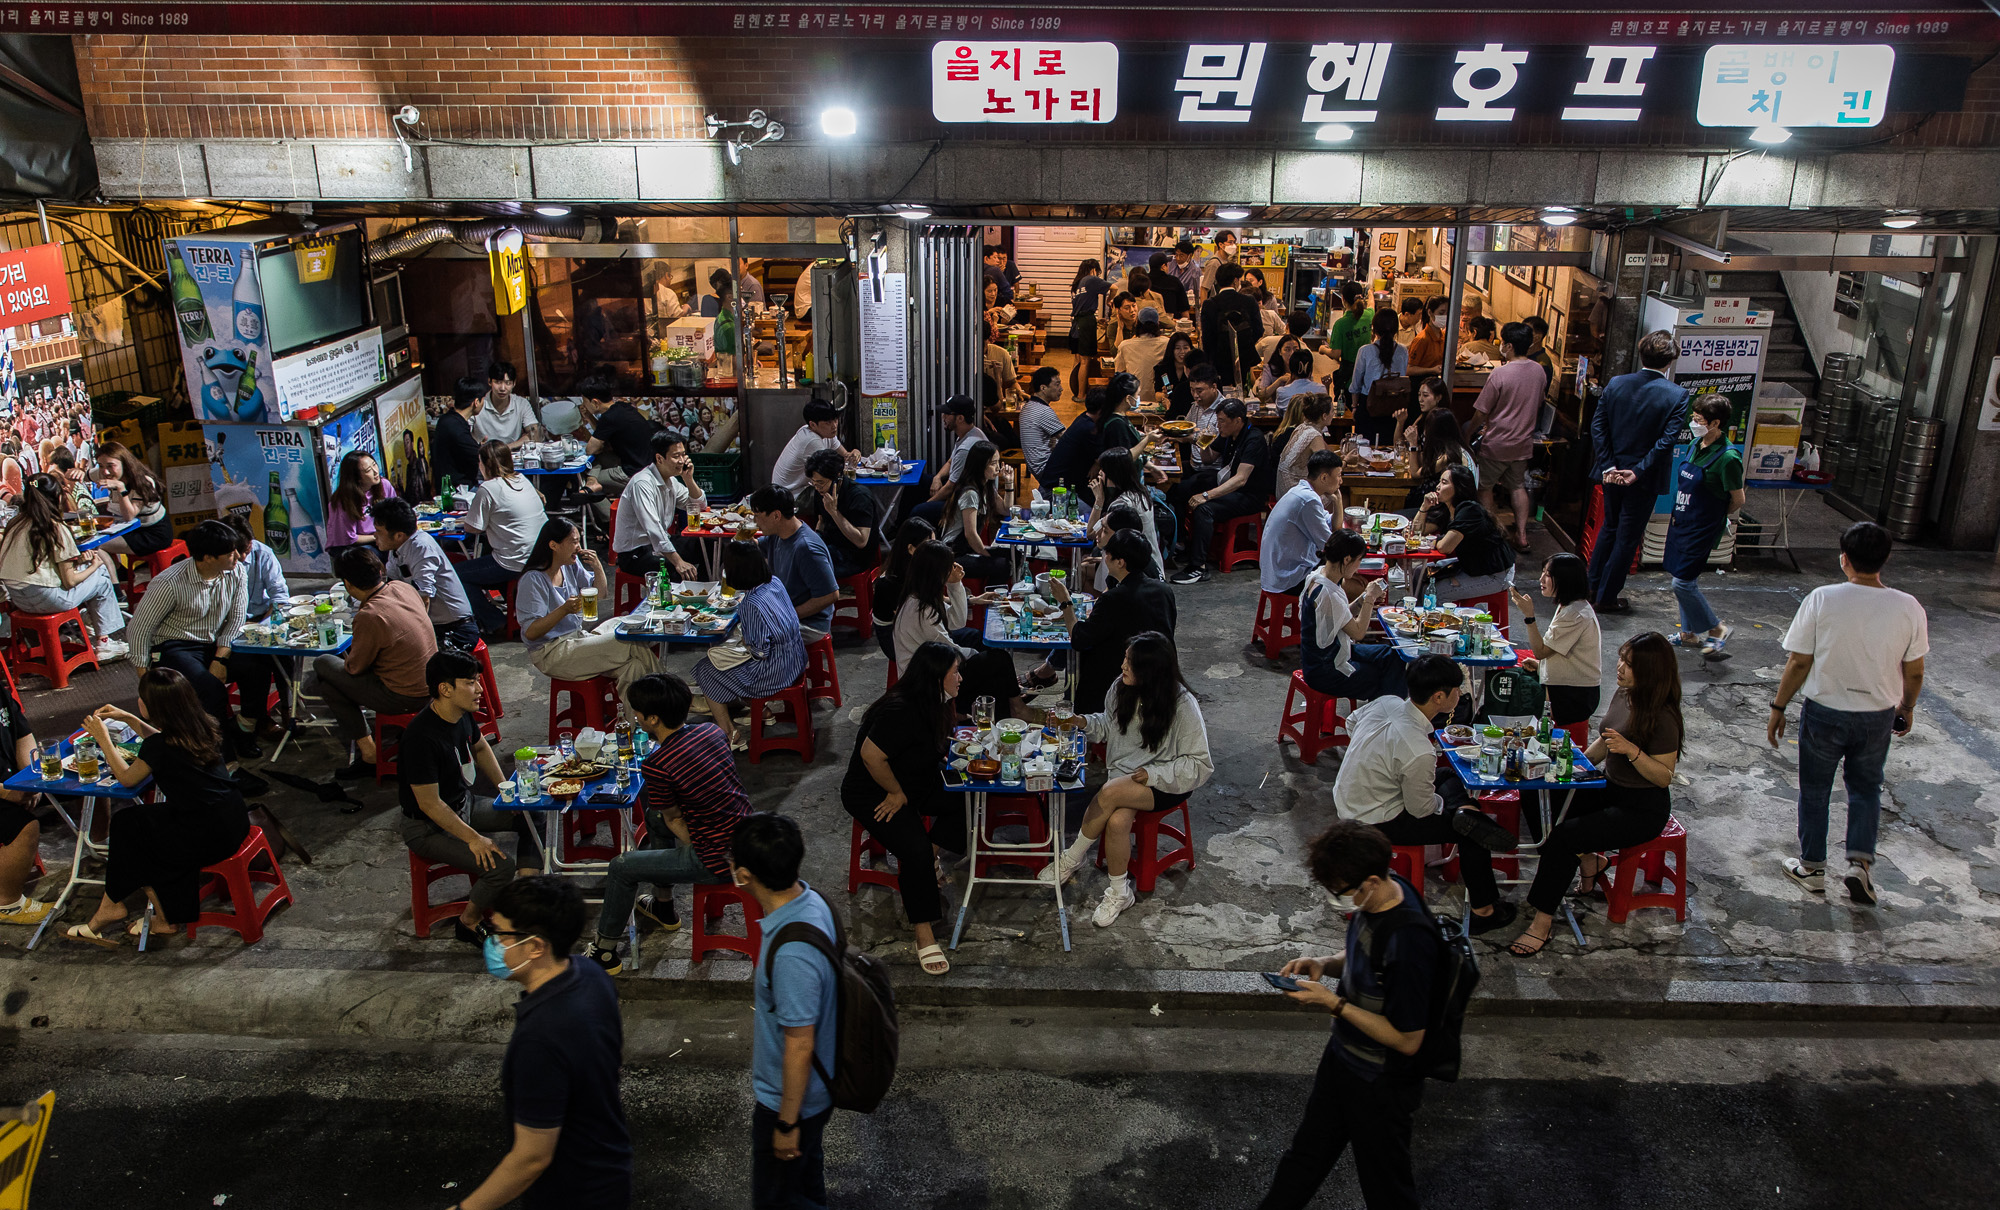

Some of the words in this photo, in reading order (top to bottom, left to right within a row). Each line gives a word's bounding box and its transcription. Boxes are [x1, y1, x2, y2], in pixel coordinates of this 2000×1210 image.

[0, 10, 19, 25] 리
[30, 10, 113, 26] 을지로골뱅이
[121, 13, 154, 26] Since
[159, 13, 189, 25] 1989
[733, 14, 790, 29] 뮌헨호프
[798, 13, 885, 29] 을지로노가리
[895, 15, 984, 31] 을지로골뱅이
[991, 17, 1024, 30] Since
[1029, 16, 1062, 30] 1989
[1609, 21, 1670, 36] 뮌헨호프
[1676, 20, 1768, 36] 을지로노가리
[1776, 21, 1868, 36] 을지로골뱅이
[1875, 21, 1910, 35] Since
[1915, 21, 1950, 34] 1989
[947, 46, 1066, 81] 을지로
[1716, 50, 1839, 86] 골뱅이
[1174, 43, 1656, 122] 뮌헨호프
[983, 88, 1100, 121] 노가리
[187, 247, 234, 266] TERRA
[1650, 256, 1666, 264] 화중
[0, 261, 27, 286] 가리
[506, 253, 524, 279] Max
[7, 284, 50, 314] 있어요!
[180, 310, 206, 325] TERRA
[1717, 316, 1731, 324] Self
[676, 335, 694, 346] 팝콘
[1680, 339, 1760, 357] 냉수전용냉장고
[1701, 358, 1734, 372] (Self)
[1734, 382, 1753, 392] 100%
[398, 395, 421, 431] Max
[257, 431, 304, 447] TERRA
[1675, 490, 1692, 506] Max
[229, 504, 252, 515] TERRA
[266, 530, 288, 540] TERRA
